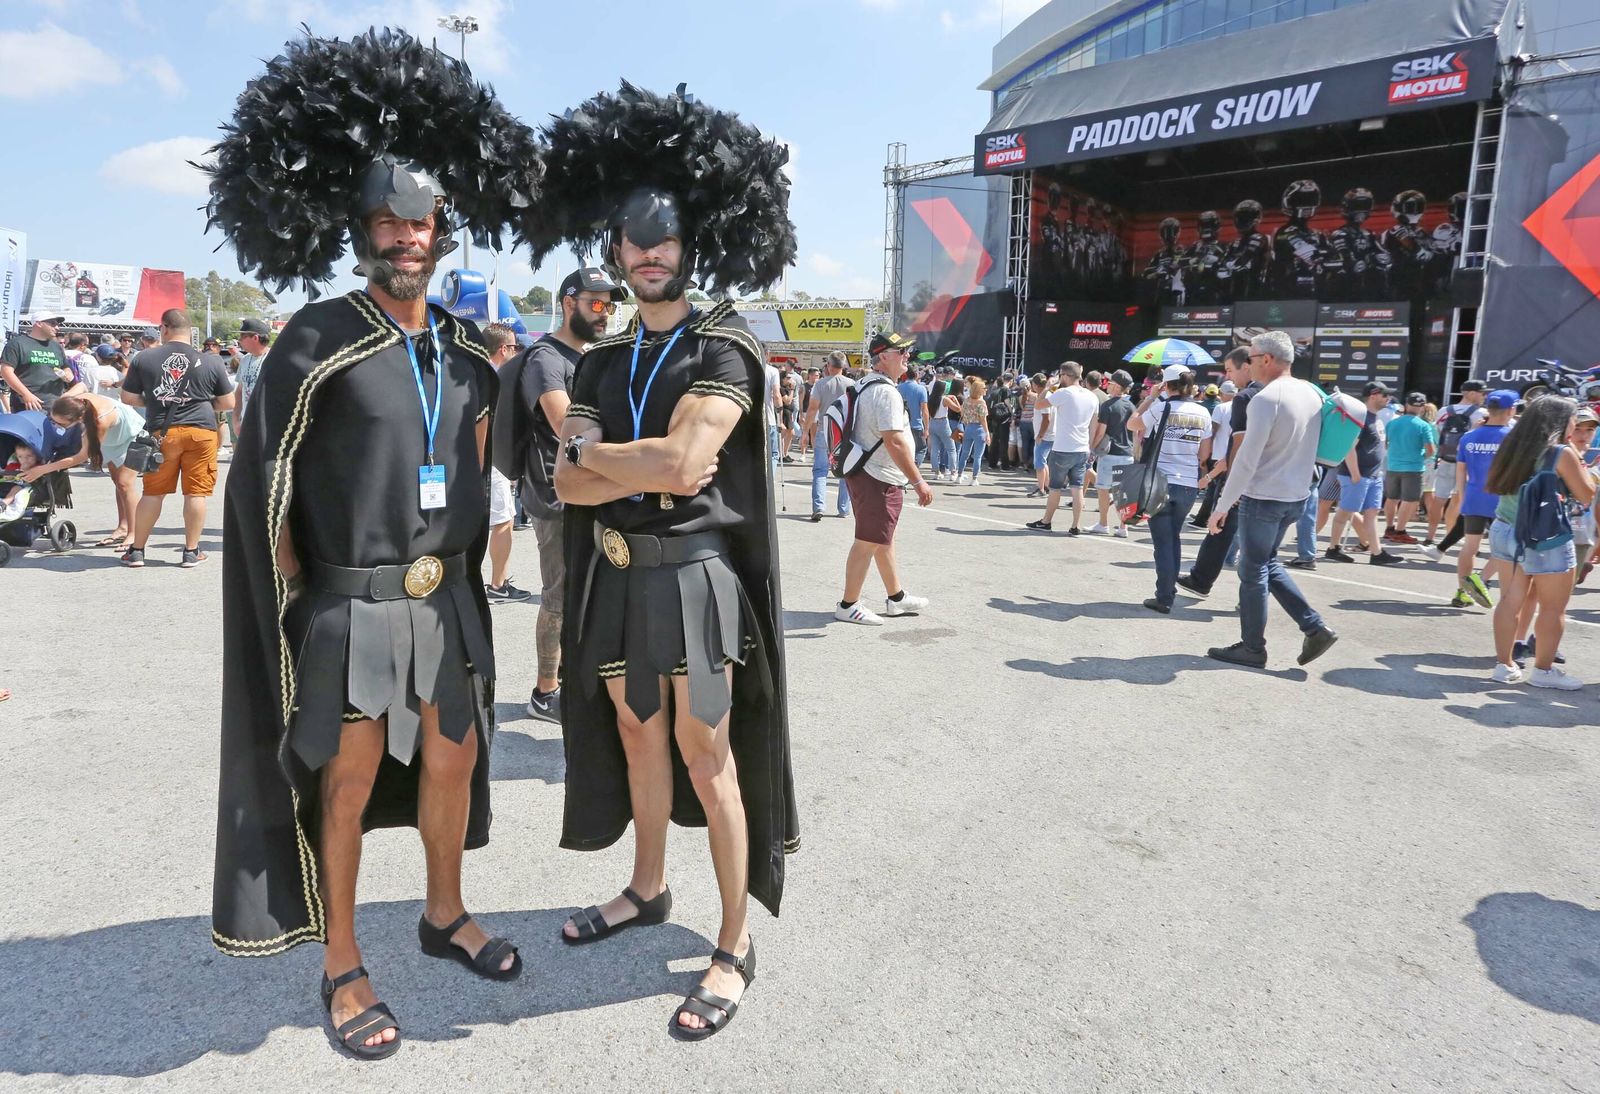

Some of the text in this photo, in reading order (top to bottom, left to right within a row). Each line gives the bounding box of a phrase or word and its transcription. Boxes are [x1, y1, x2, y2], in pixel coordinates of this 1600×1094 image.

[1390, 52, 1456, 82] SBK
[1392, 75, 1463, 98] MOTUL
[1067, 81, 1322, 153] PADDOCK SHOW
[986, 133, 1019, 152] SBK
[988, 149, 1024, 164] MOTUL
[2, 270, 13, 320] HYUNDAI
[1075, 323, 1109, 334] MOTUL
[31, 350, 56, 358] TEAM
